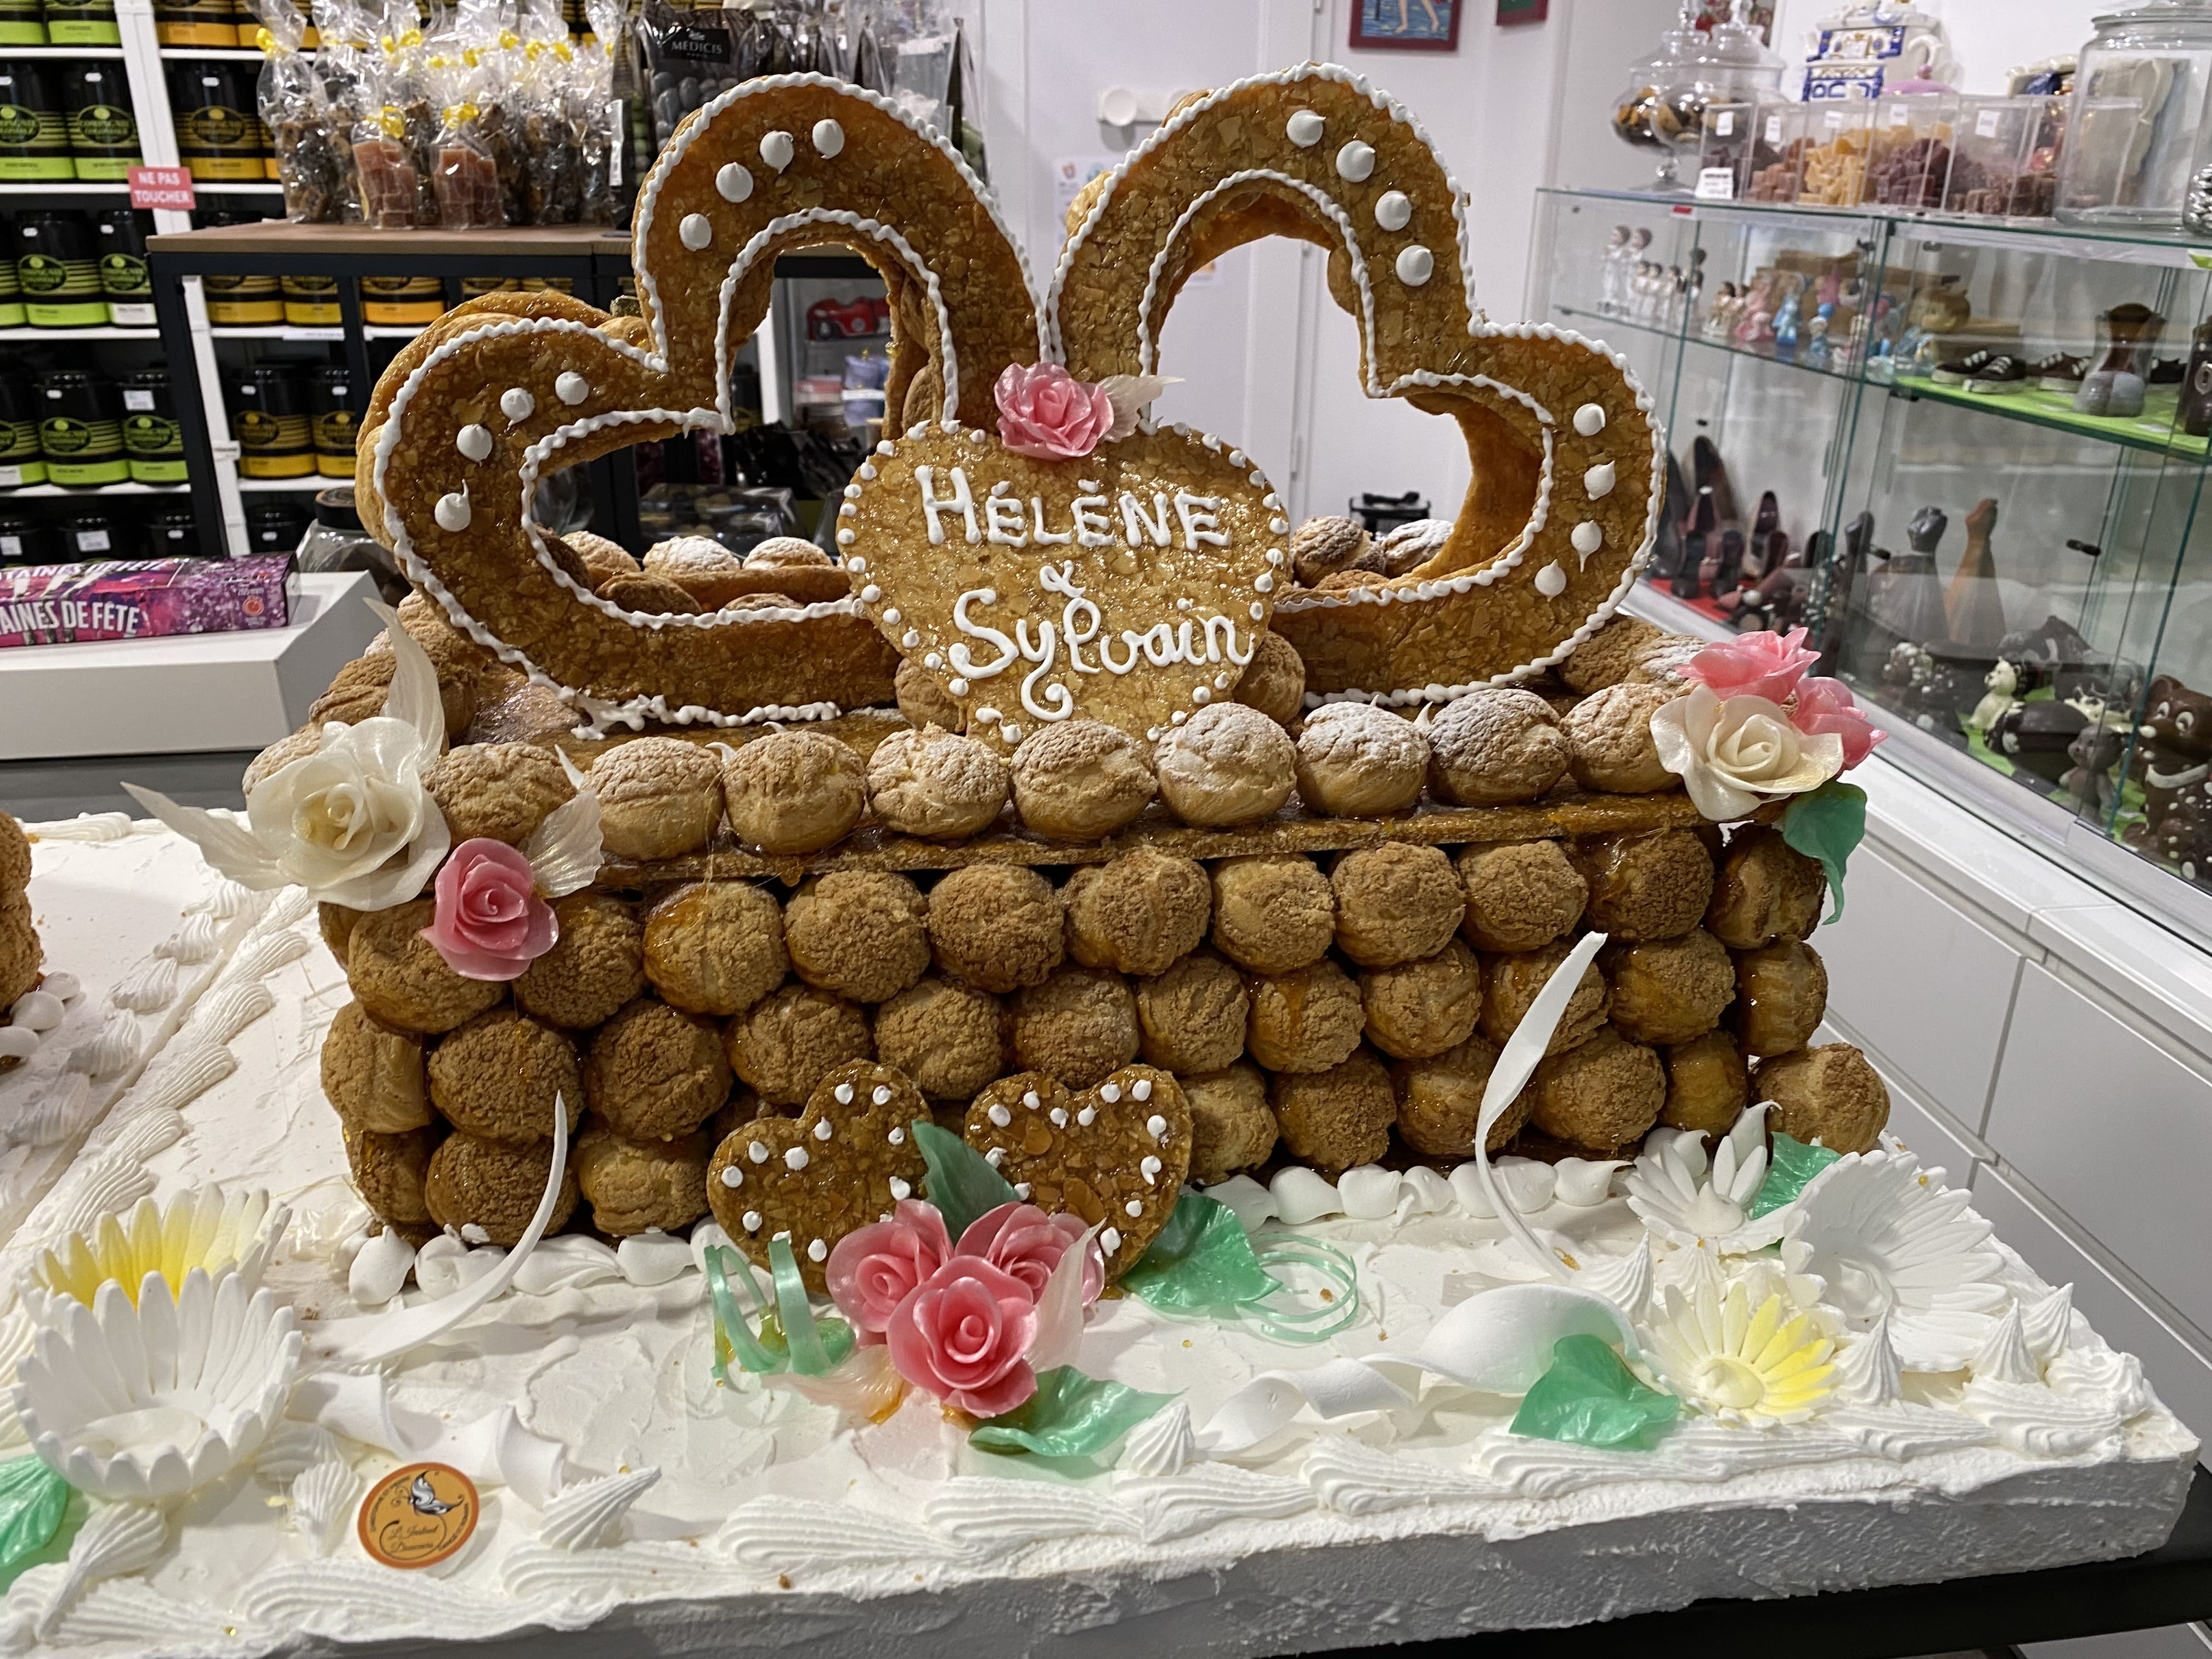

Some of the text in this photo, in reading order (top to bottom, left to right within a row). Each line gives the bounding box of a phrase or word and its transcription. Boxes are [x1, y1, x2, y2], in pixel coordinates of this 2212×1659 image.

[138, 172, 180, 185] NE PAS
[134, 189, 190, 204] TOUCHER
[1039, 560, 1087, 598] &
[0, 600, 140, 635] AINES DE FÊTE
[948, 588, 1256, 723] Sylvain
